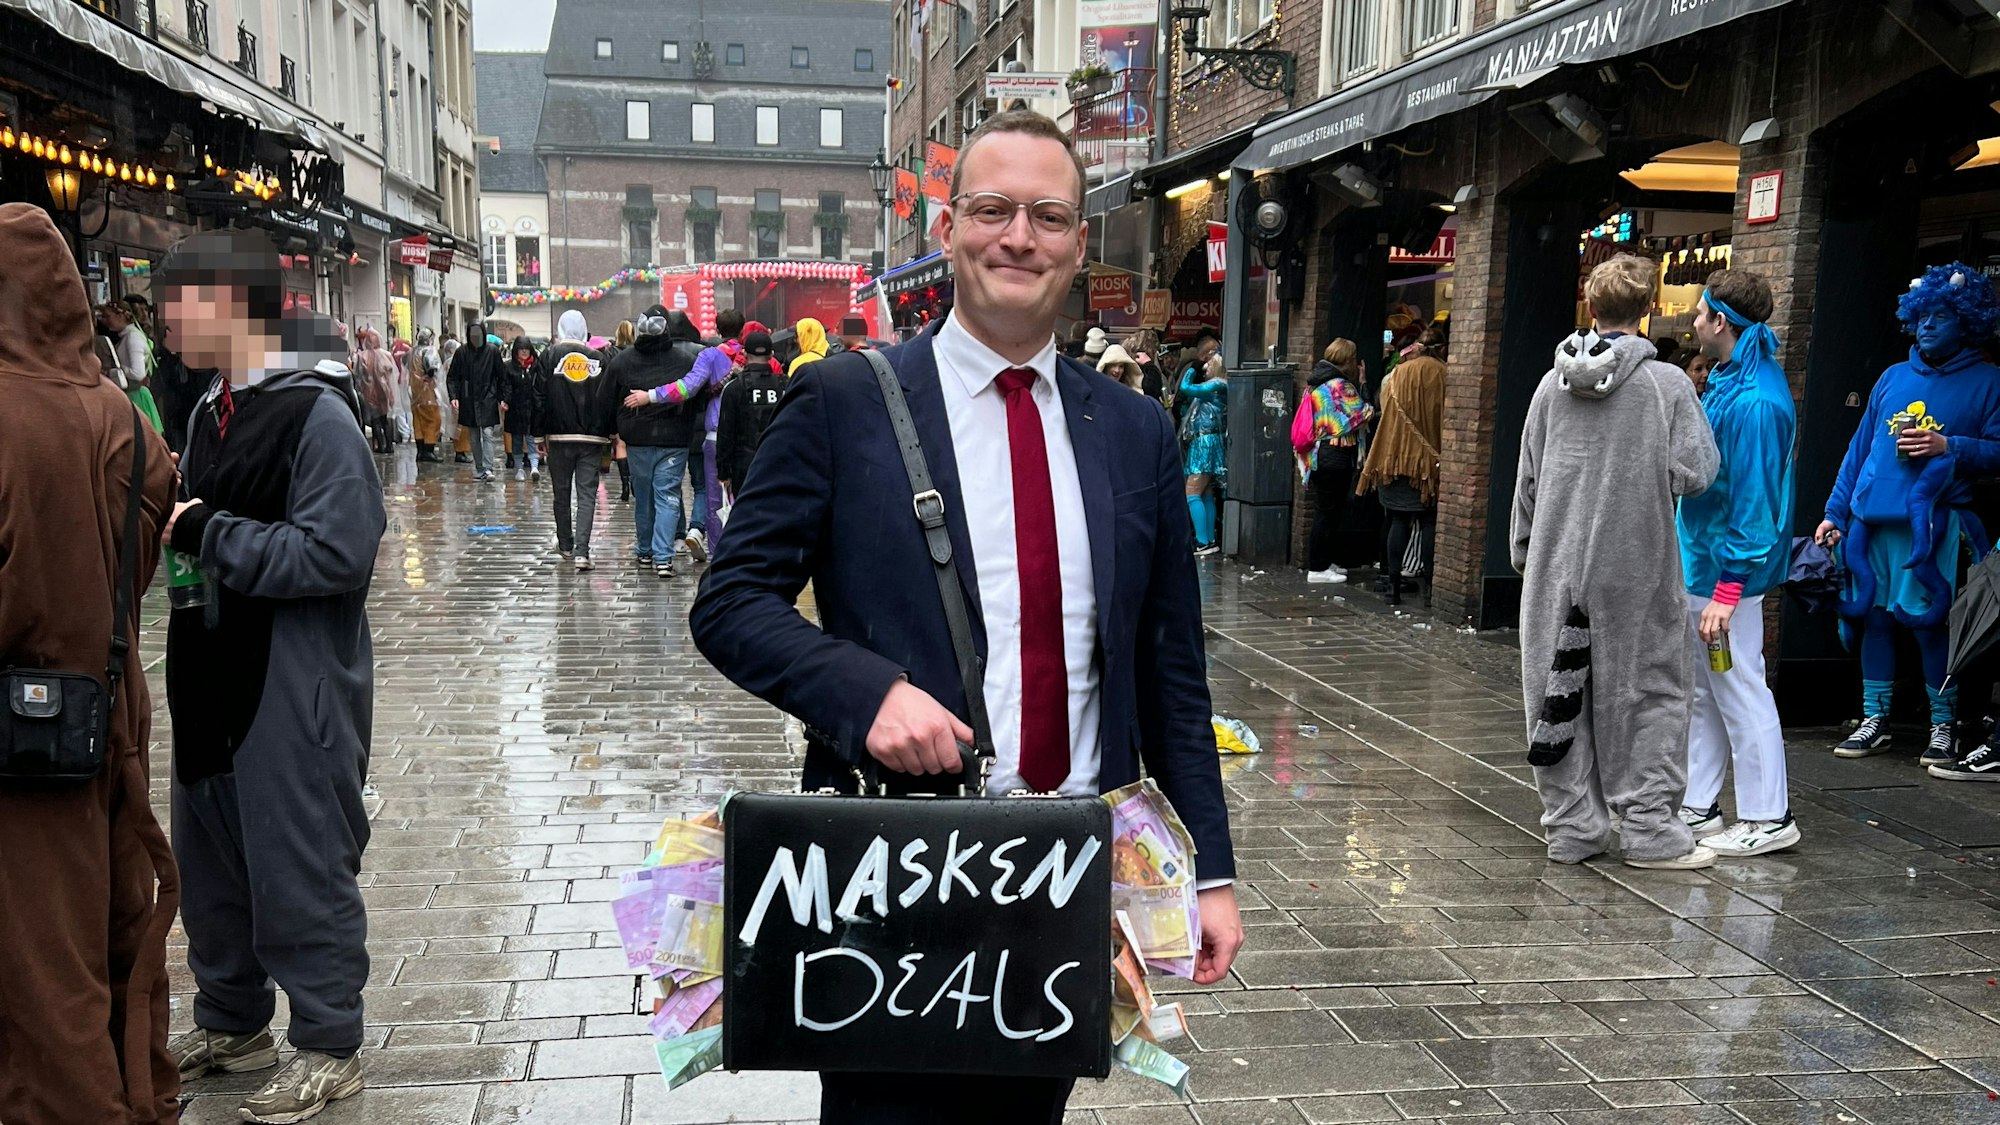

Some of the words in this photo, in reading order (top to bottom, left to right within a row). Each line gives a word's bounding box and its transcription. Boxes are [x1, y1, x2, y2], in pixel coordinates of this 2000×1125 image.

[1487, 7, 1622, 85] MANHATTAN
[1406, 77, 1458, 109] RESTAURANT
[1315, 120, 1339, 142] STEAKS
[1345, 112, 1365, 131] TAPAS
[402, 246, 427, 257] KIOSK
[1091, 276, 1131, 292] KIOSK
[1145, 297, 1167, 315] KIOSK
[1171, 301, 1220, 317] KIOSK
[554, 357, 602, 377] LAKERS
[739, 829, 1102, 945] MASKEN
[627, 948, 653, 966] 500
[655, 950, 676, 964] 200
[794, 947, 1080, 1042] DEALS
